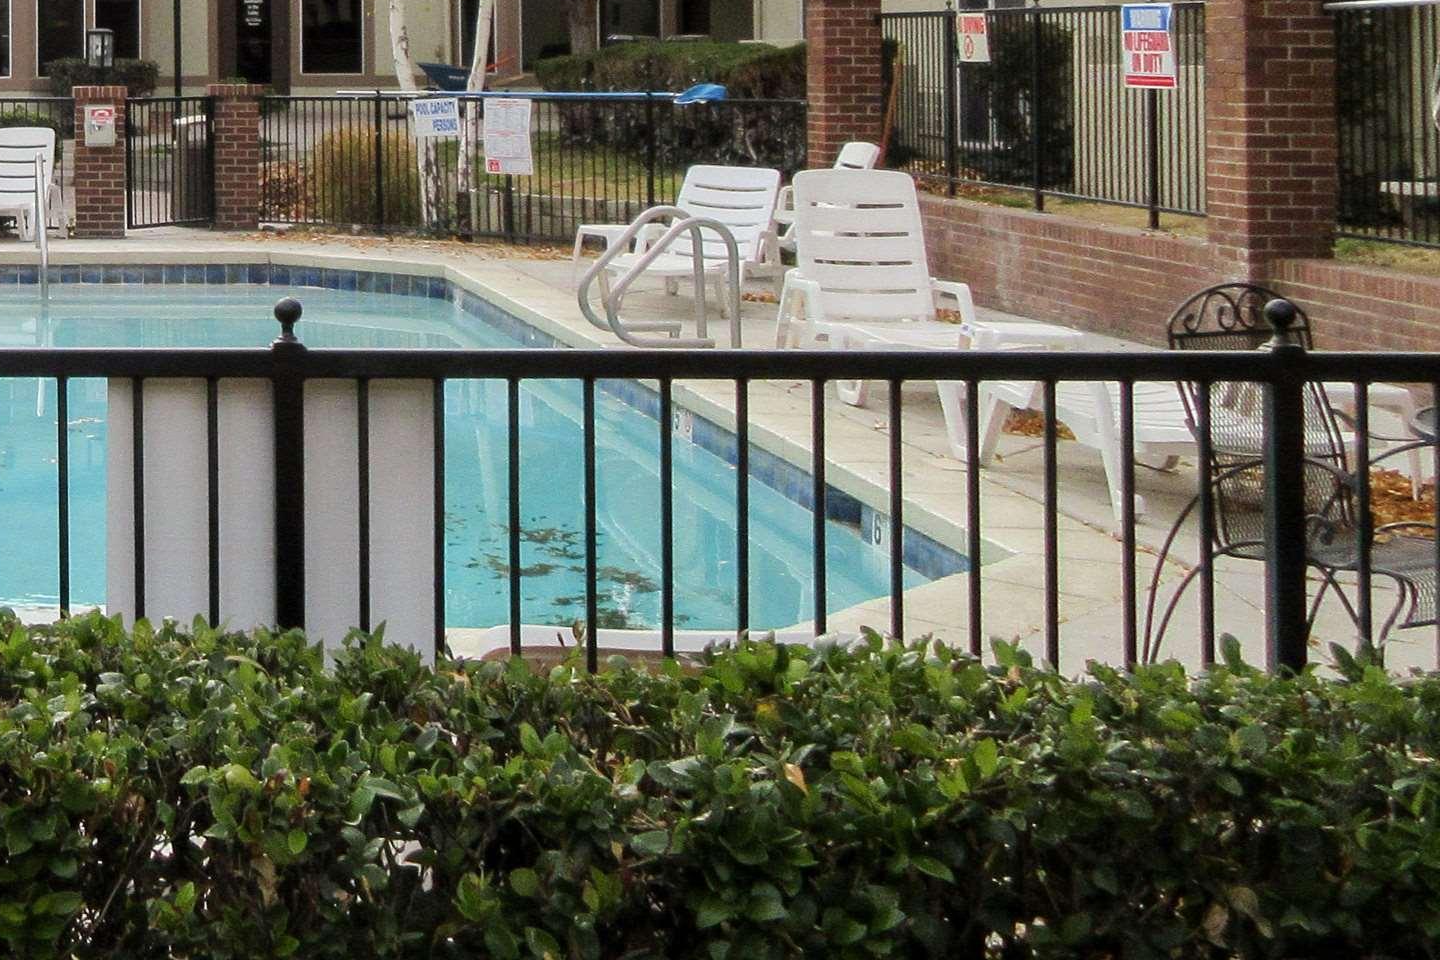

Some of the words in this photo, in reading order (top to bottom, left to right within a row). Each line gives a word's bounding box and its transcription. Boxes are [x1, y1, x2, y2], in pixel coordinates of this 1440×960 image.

[1143, 53, 1163, 73] DUTY
[415, 103, 430, 115] POOL
[430, 101, 456, 114] CAPACITY
[432, 118, 458, 132] PERSONS
